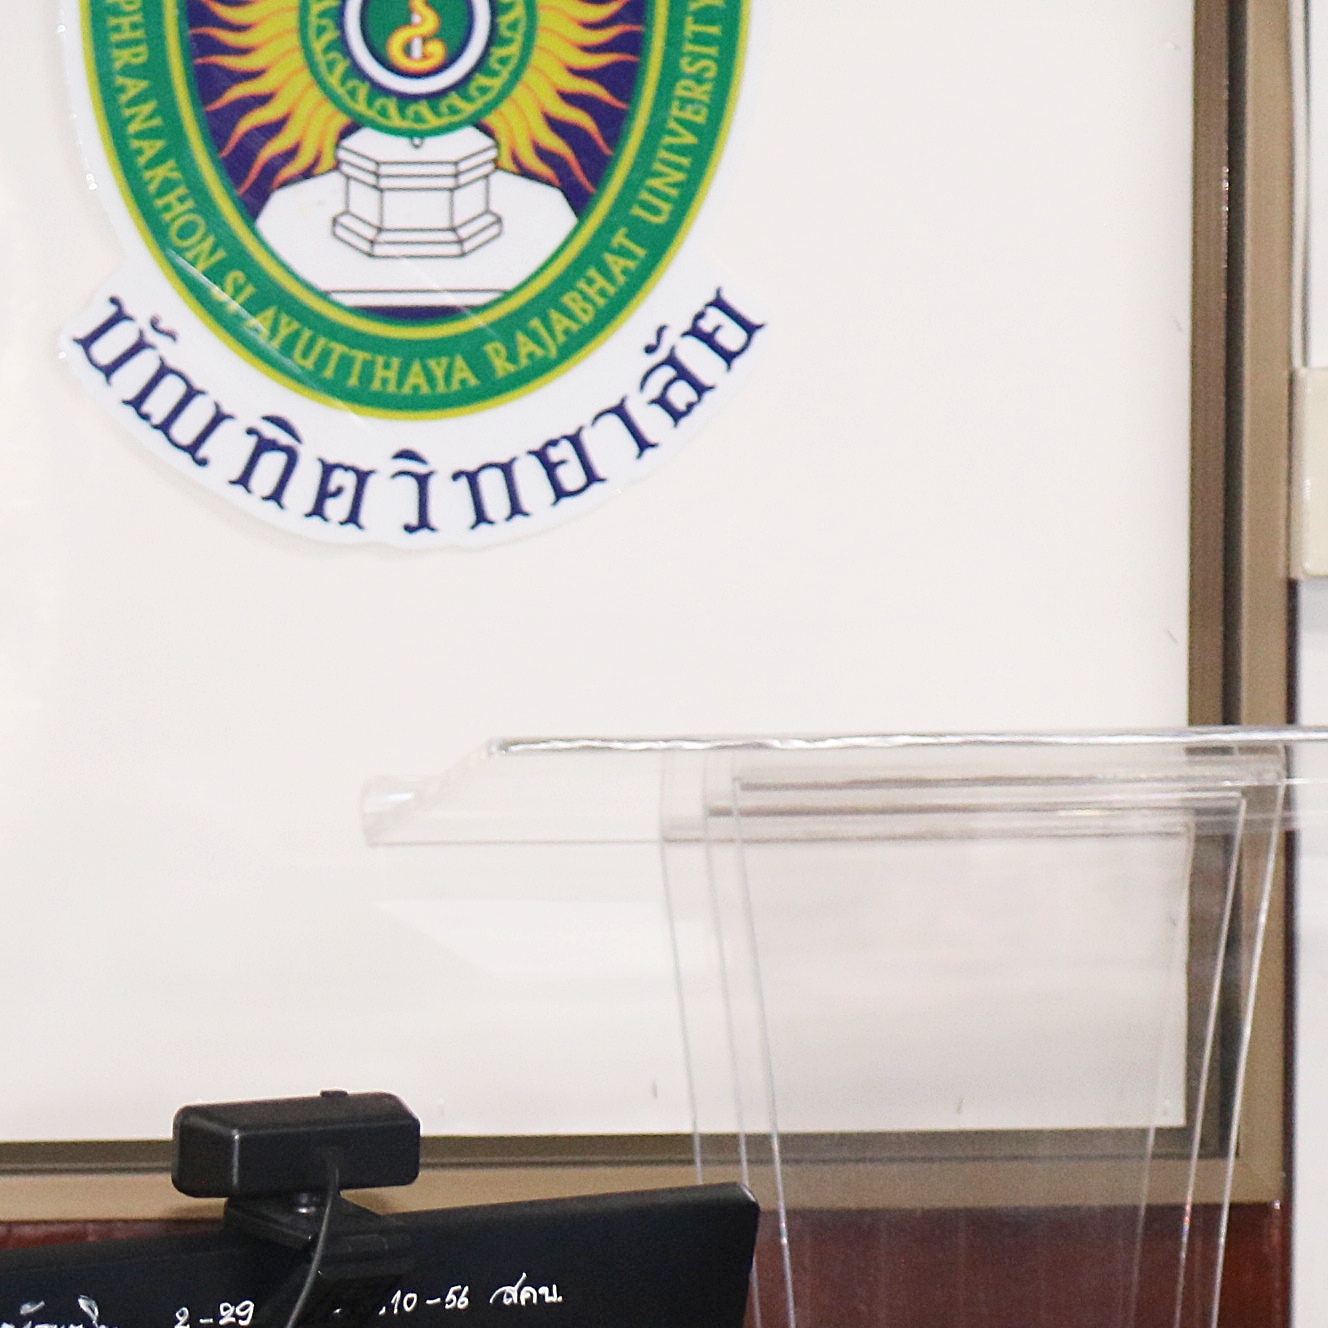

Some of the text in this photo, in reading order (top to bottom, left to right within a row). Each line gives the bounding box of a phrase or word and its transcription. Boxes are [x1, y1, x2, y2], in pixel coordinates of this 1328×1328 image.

[105, 0, 225, 274] PHRANAKHON
[211, 269, 257, 314] SI
[246, 304, 481, 395] AYUTTHAYA
[483, 226, 649, 379] RAJABHAT
[72, 286, 766, 534] บัณฑิตวิทยาลัย
